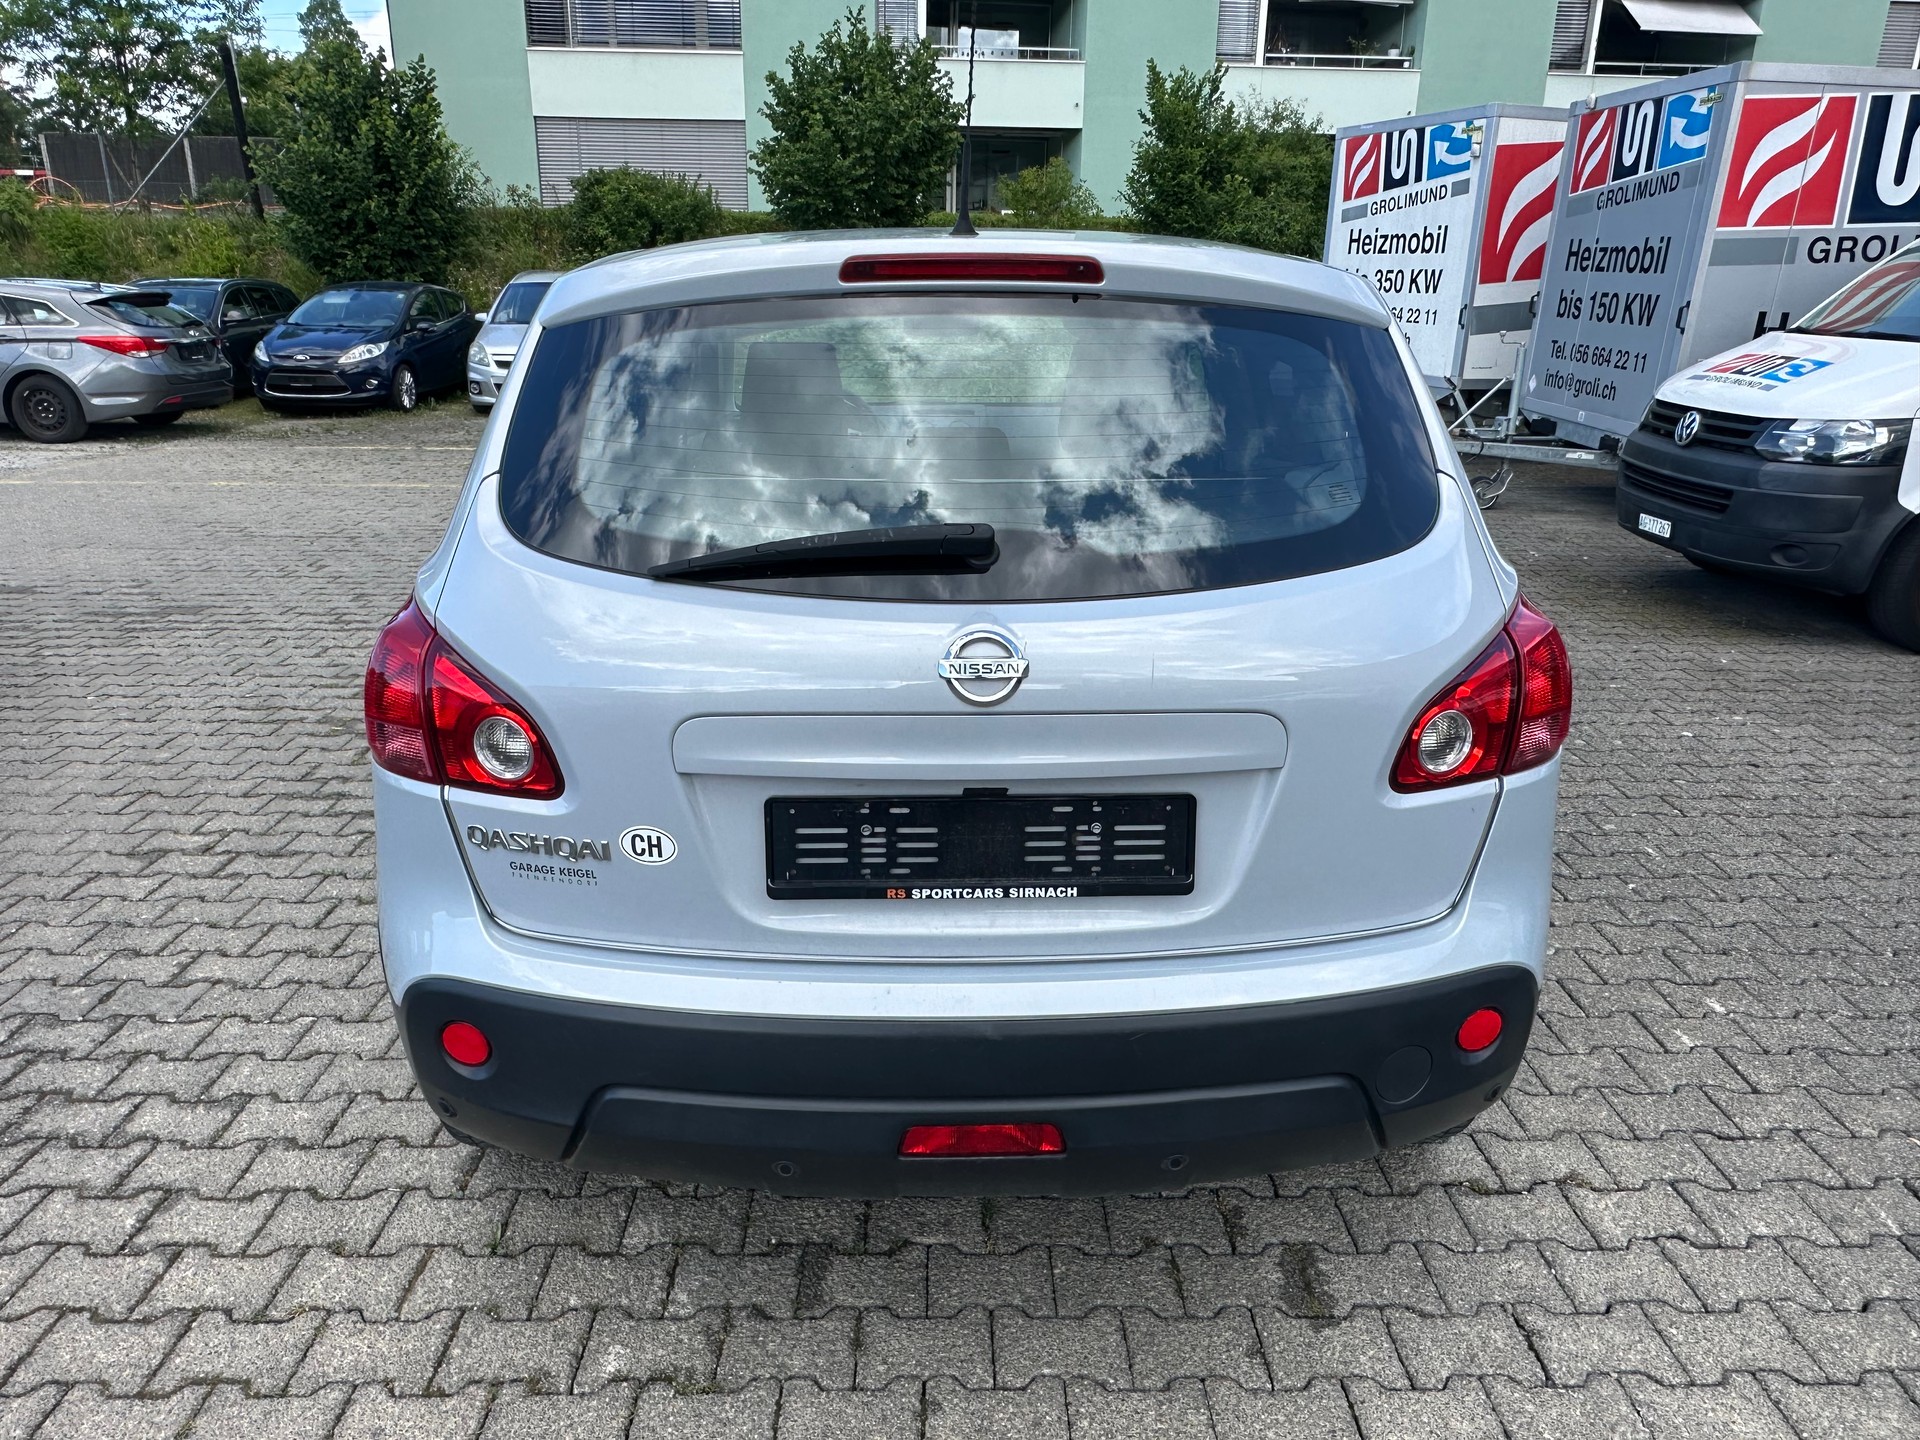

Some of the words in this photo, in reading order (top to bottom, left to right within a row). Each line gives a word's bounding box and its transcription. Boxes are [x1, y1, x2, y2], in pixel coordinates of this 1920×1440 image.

[1370, 184, 1448, 216] GROLIMUND
[1597, 171, 1680, 211] GROLIMUND
[1347, 225, 1449, 255] Heizmobil
[1565, 236, 1672, 275] Heizmobil
[1374, 268, 1405, 294] 350
[1408, 268, 1443, 294] KW
[1406, 308, 1421, 324] 22
[1424, 309, 1438, 326] 11
[1556, 289, 1583, 320] bis
[1588, 291, 1620, 324] 150
[1621, 292, 1661, 327] KW
[1550, 340, 1567, 361] Tel.
[1570, 343, 1589, 365] 056
[1591, 345, 1612, 368] 664
[1614, 349, 1630, 371] 22
[1633, 352, 1647, 374] 11
[1544, 368, 1617, 401] info@groli.ch
[948, 663, 1020, 675] NISSAN
[467, 824, 613, 863] QASHQAI
[631, 833, 664, 858] CH
[509, 861, 556, 876] GARAGE
[559, 867, 597, 880] KEIGEL
[886, 888, 906, 899] RS
[911, 888, 1004, 899] SPORTCARS
[1008, 887, 1078, 898] SIRNACH
